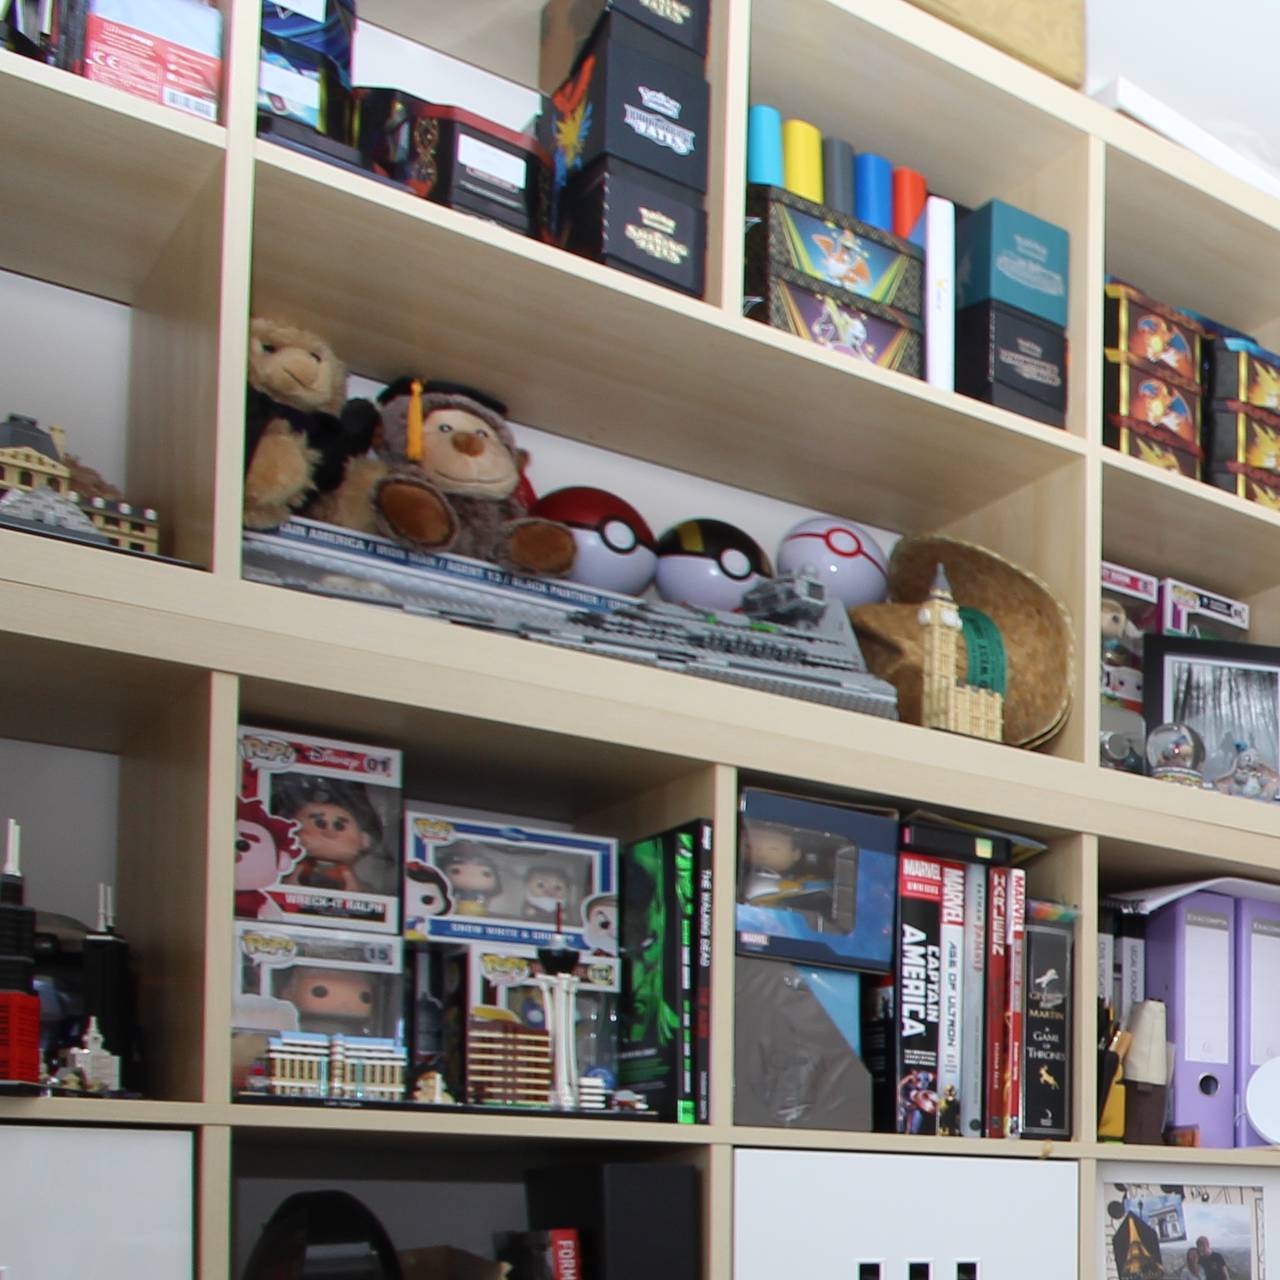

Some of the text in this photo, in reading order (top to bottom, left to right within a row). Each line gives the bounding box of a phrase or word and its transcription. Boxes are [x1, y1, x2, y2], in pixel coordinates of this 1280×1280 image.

[702, 869, 712, 889] THE
[903, 858, 941, 881] MARVEL
[943, 867, 964, 922] MARVEL
[1014, 875, 1024, 930] MARVEL
[701, 891, 712, 936] WALKING
[700, 938, 712, 967] DEAD
[948, 940, 957, 967] AGE
[902, 923, 927, 1037] AMERICA
[926, 944, 940, 1023] CAPTAIN
[948, 973, 957, 992] OF
[948, 996, 957, 1047] ULTRON
[1033, 1031, 1060, 1043] GAME
[1027, 1047, 1066, 1061] THRONES
